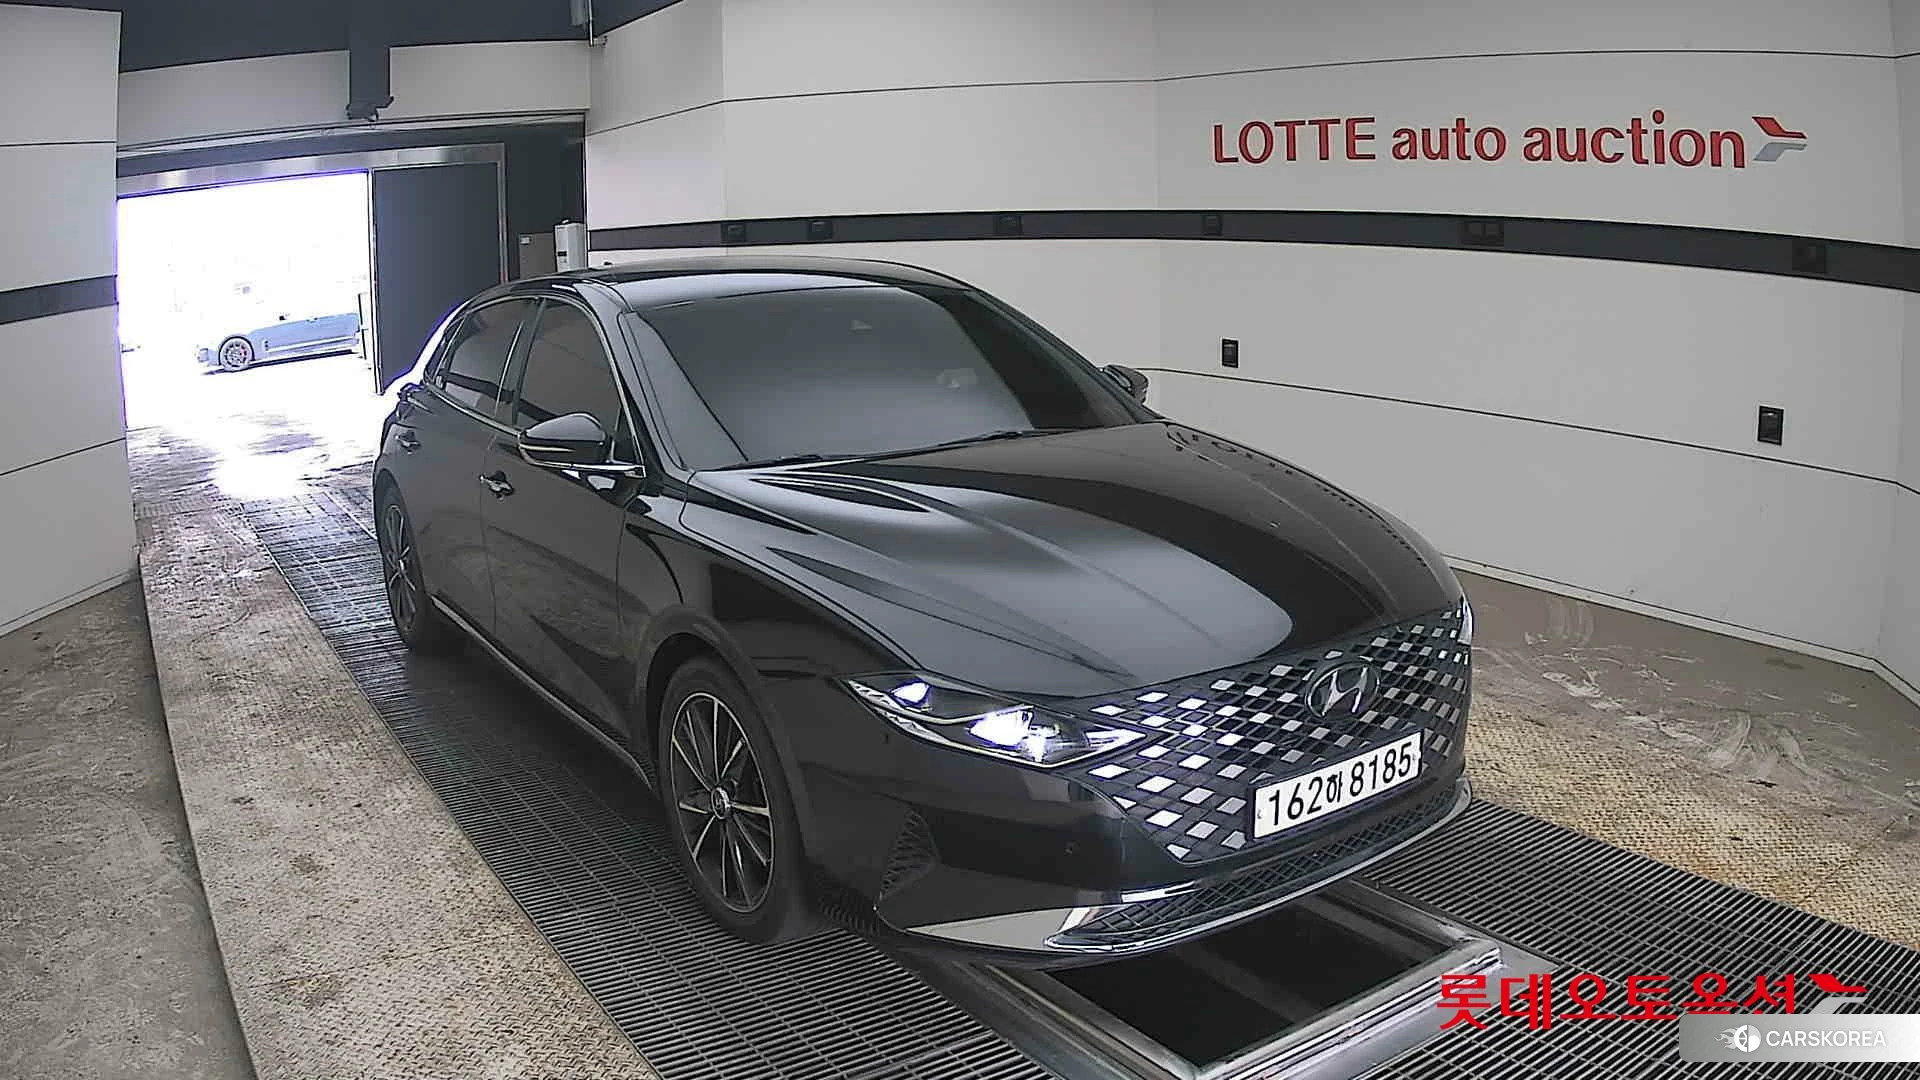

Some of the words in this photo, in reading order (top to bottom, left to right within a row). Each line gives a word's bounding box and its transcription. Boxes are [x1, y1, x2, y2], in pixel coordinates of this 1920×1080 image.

[1212, 117, 1377, 163] LOTTE
[1391, 117, 1507, 161] auto
[1522, 110, 1746, 169] auction
[1268, 771, 1344, 826] 162하
[1349, 741, 1413, 797] 8185
